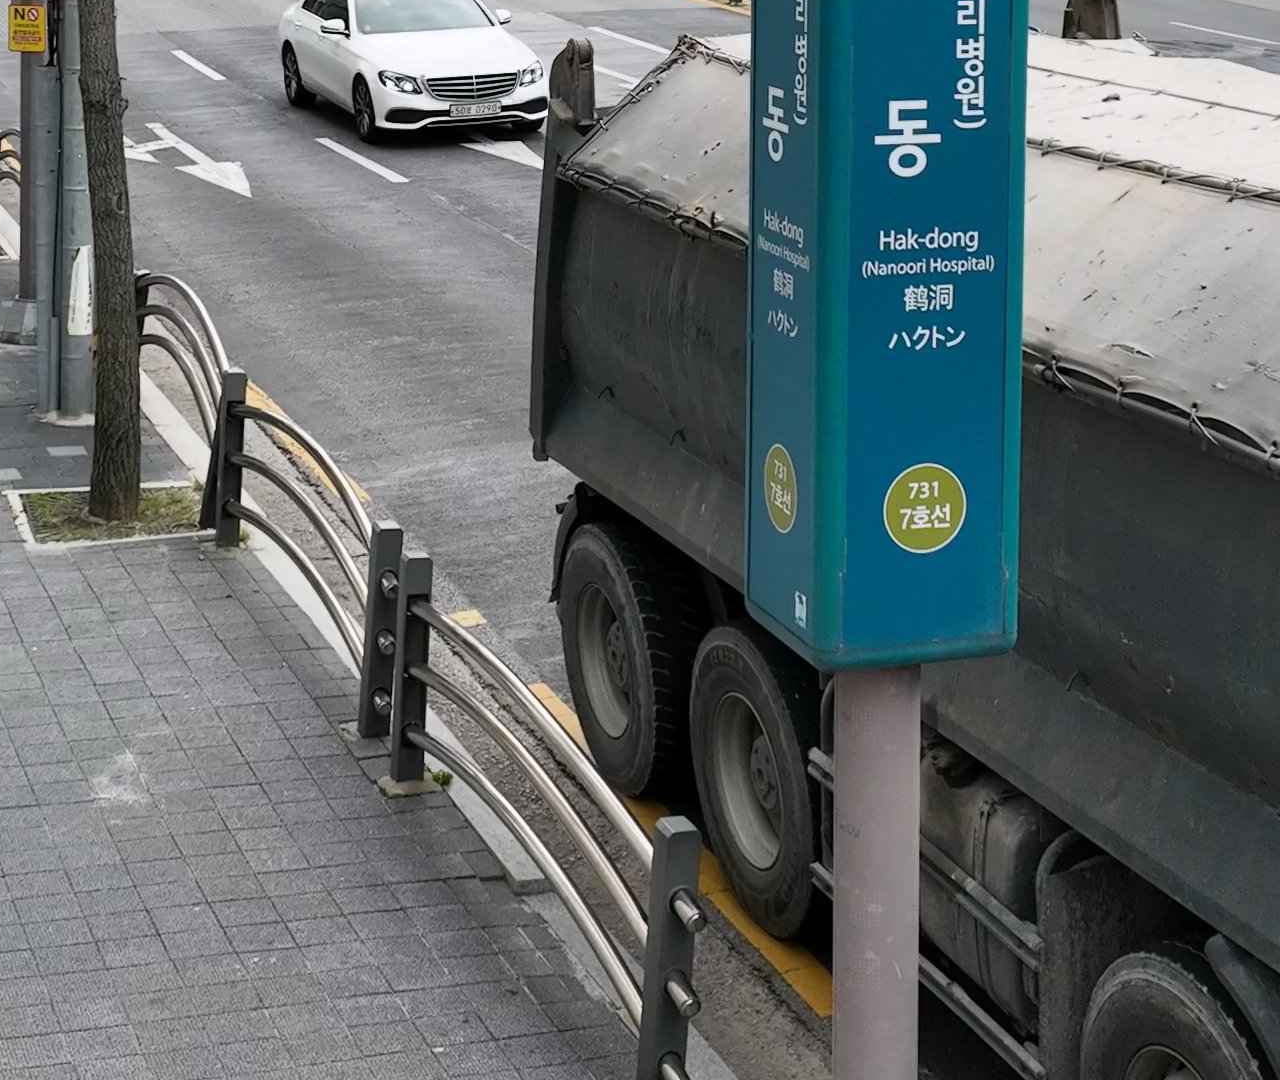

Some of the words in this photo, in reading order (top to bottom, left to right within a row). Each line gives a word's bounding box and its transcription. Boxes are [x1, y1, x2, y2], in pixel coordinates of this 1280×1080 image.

[763, 208, 804, 248] Hak-dong
[879, 226, 979, 252] Hak-dong
[862, 259, 926, 278] (Nanoori
[930, 255, 995, 275] Hospital)
[767, 309, 799, 337] ハクトン
[888, 325, 966, 350] ハクトン
[774, 459, 787, 482] 731
[770, 481, 792, 516] 7호선
[908, 481, 940, 500] 731
[900, 506, 951, 531] 7호선
